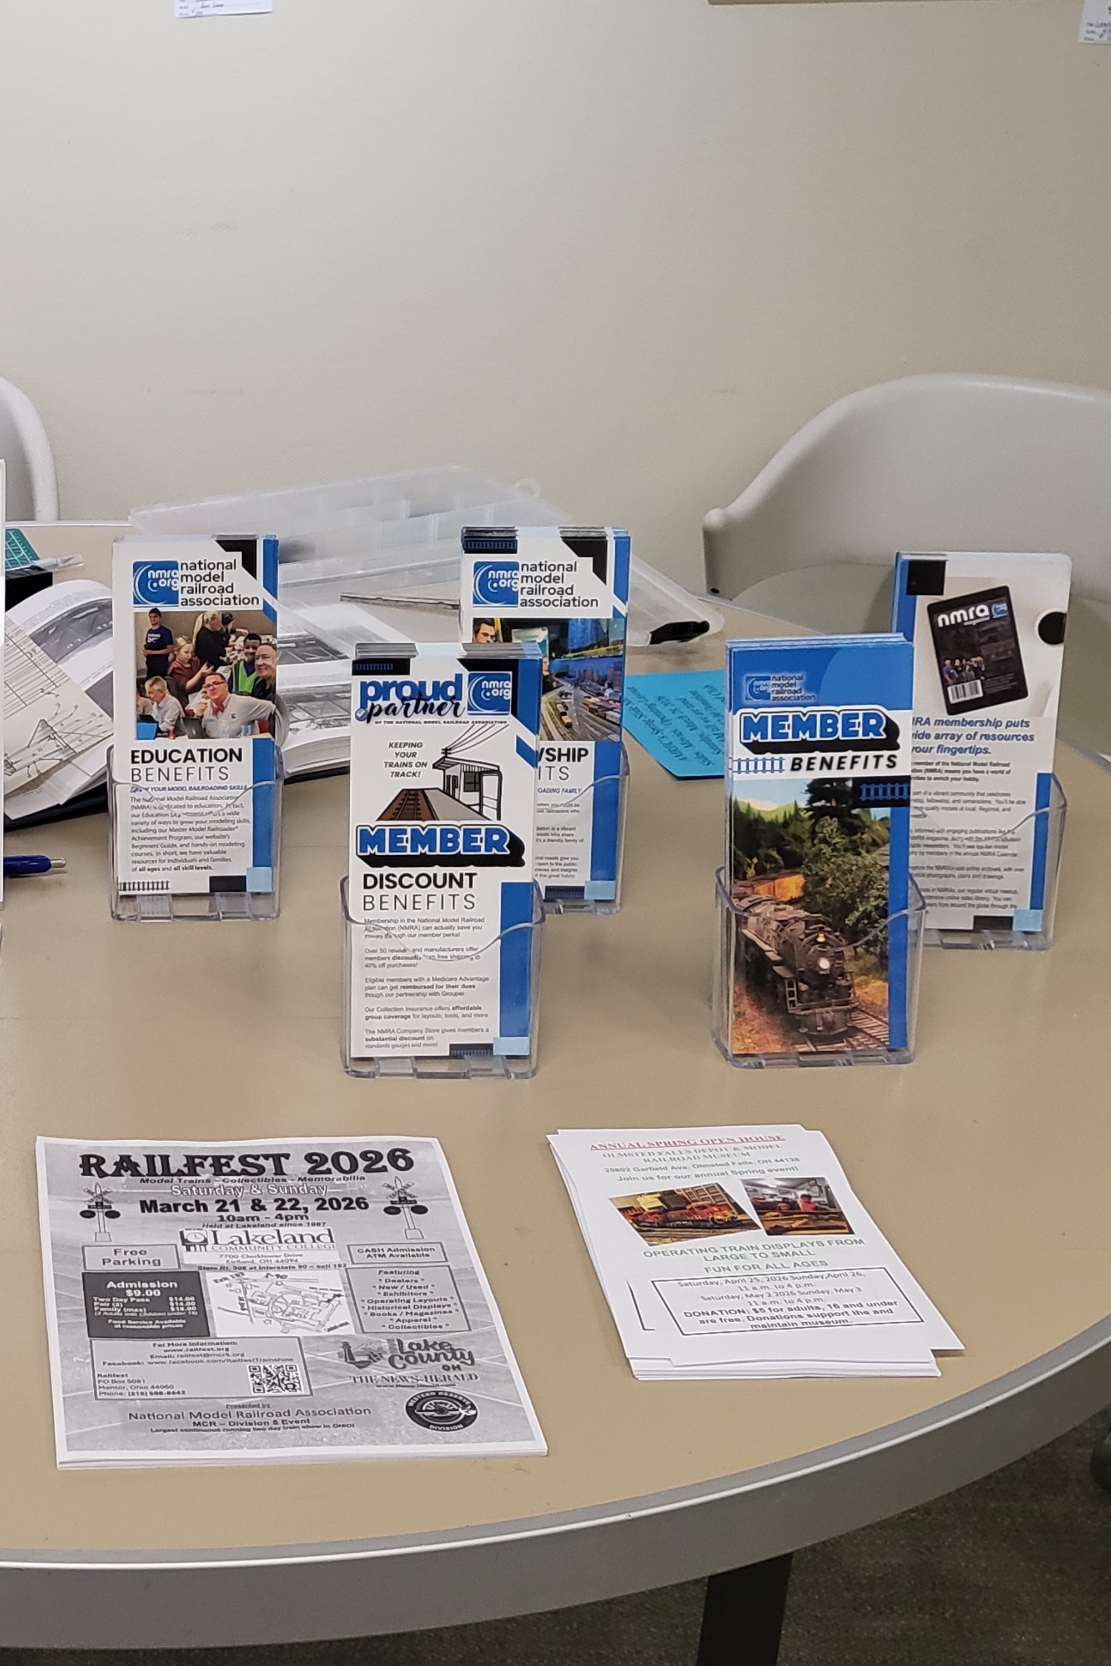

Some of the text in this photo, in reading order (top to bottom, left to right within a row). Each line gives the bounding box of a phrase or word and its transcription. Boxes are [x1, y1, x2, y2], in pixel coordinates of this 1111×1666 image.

[180, 560, 236, 571] national
[520, 561, 577, 573] national
[148, 570, 178, 579] nmra
[180, 572, 224, 583] model
[488, 571, 519, 579] nmra
[520, 573, 564, 584] model
[180, 584, 234, 594] railroad
[520, 584, 574, 596] railroad
[180, 595, 259, 606] association
[520, 596, 598, 608] association
[938, 604, 990, 627] nmra
[482, 680, 510, 688] nmra
[360, 673, 463, 708] proud
[367, 691, 465, 723] partner
[742, 711, 888, 743] MEMBER
[934, 718, 1030, 729] membership puts
[934, 733, 963, 742] array
[966, 731, 978, 740] of
[131, 748, 242, 764] EDUCATION
[936, 744, 991, 756] fingertips.
[790, 754, 898, 771] BENEFITS
[132, 766, 228, 782] BENEFITS
[356, 826, 512, 856] MEMBER
[364, 873, 477, 889] DISCOUNT
[364, 894, 475, 911] BENEFITS
[648, 1139, 696, 1148] SPRING
[700, 1136, 735, 1145] OPEN
[740, 1135, 786, 1143] HOUSE
[79, 1148, 414, 1178] RAILFEST 2026
[171, 1184, 327, 1198] Saturday & Sunday
[140, 1196, 369, 1213] March 21 & 22, 2026
[274, 1212, 309, 1222] 4pm
[210, 1228, 335, 1245] Lakeland
[643, 1247, 718, 1257] OPERATING
[762, 1242, 824, 1250] DISPLAYS
[771, 1250, 816, 1258] SMALL
[102, 1255, 161, 1266] Parking
[794, 1260, 828, 1268] AGES
[396, 1338, 452, 1354] Lake
[388, 1348, 475, 1369] County
[350, 1373, 478, 1384] THE NEWS-HERALD
[129, 1407, 371, 1420] National Model Railroad Association
